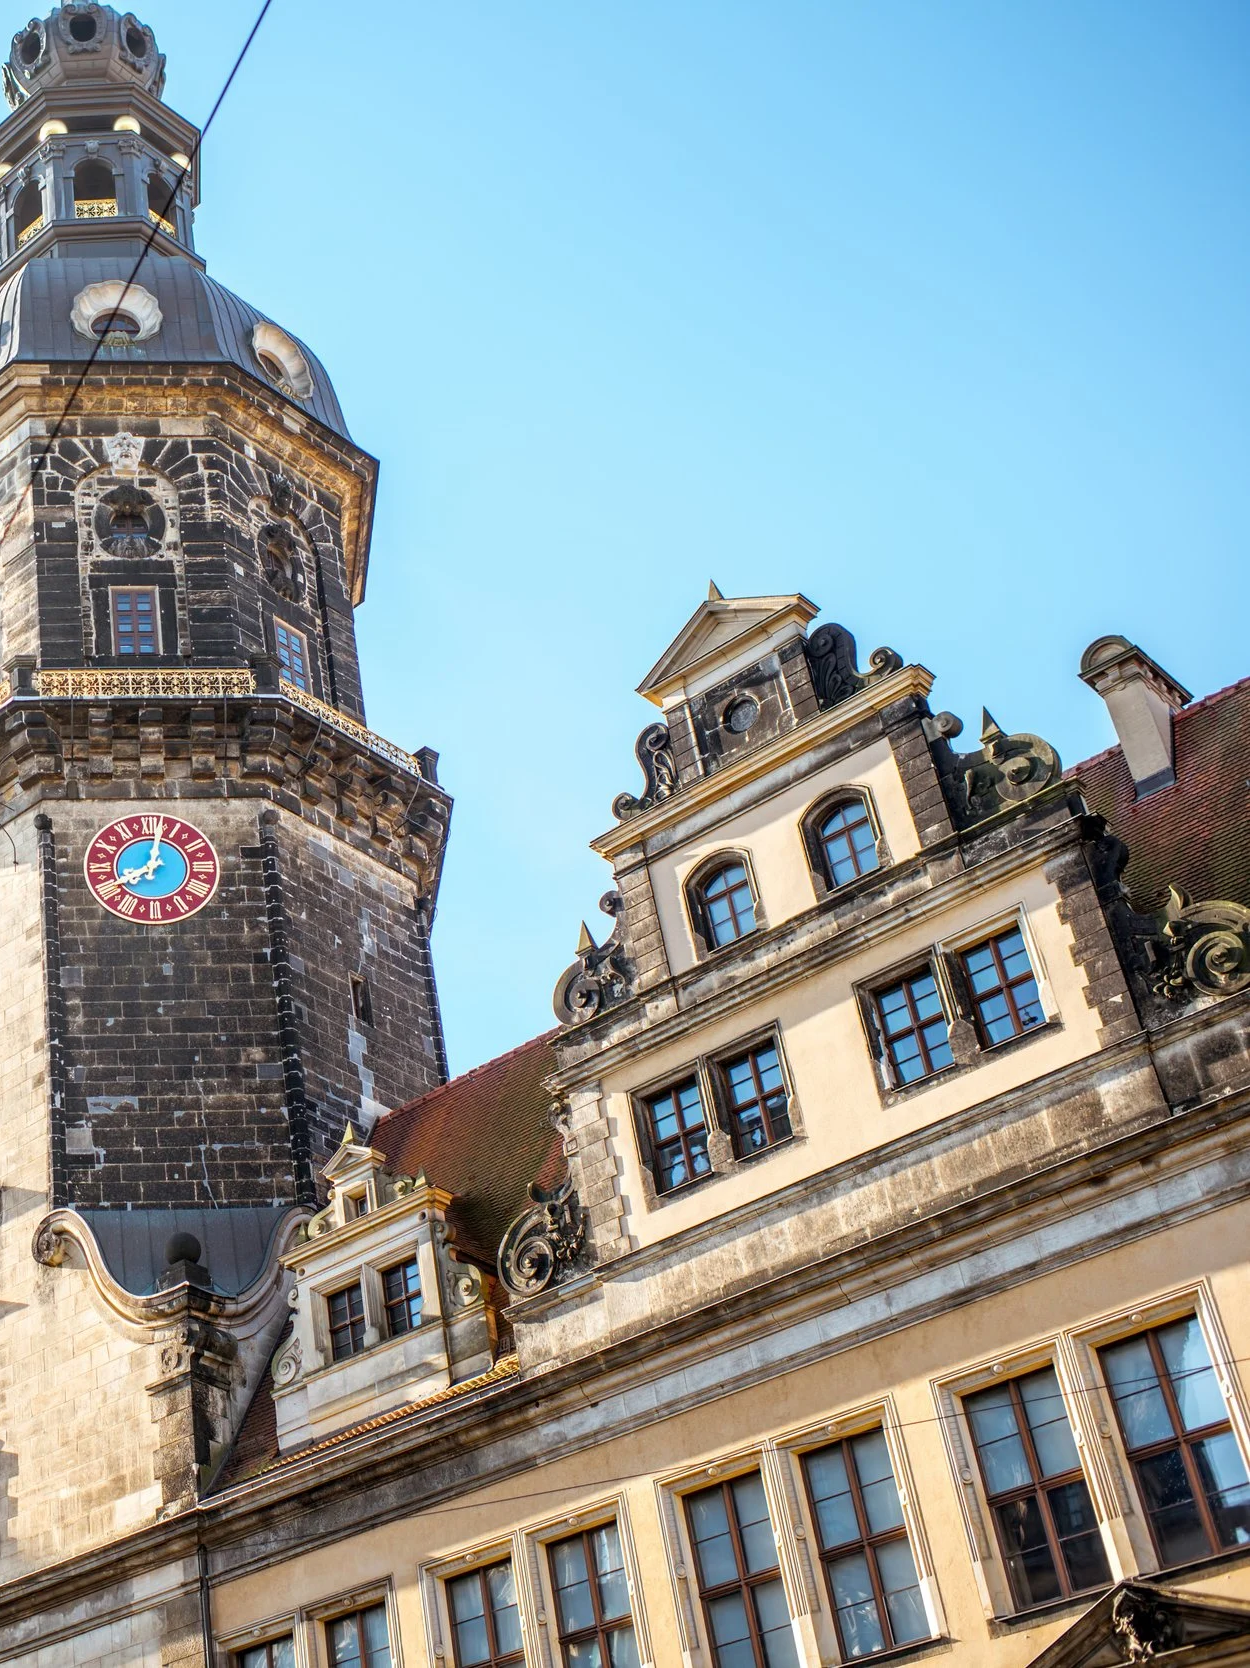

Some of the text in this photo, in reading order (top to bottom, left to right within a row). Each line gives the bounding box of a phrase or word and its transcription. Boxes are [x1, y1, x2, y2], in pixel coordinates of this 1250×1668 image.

[114, 822, 133, 841] XI
[169, 822, 181, 838] I
[95, 839, 117, 854] X
[185, 838, 205, 852] II
[89, 862, 112, 872] IX
[192, 861, 214, 872] III
[186, 879, 211, 897] IIII
[117, 894, 138, 915] VII
[150, 901, 162, 919] VI
[173, 895, 189, 913] V
